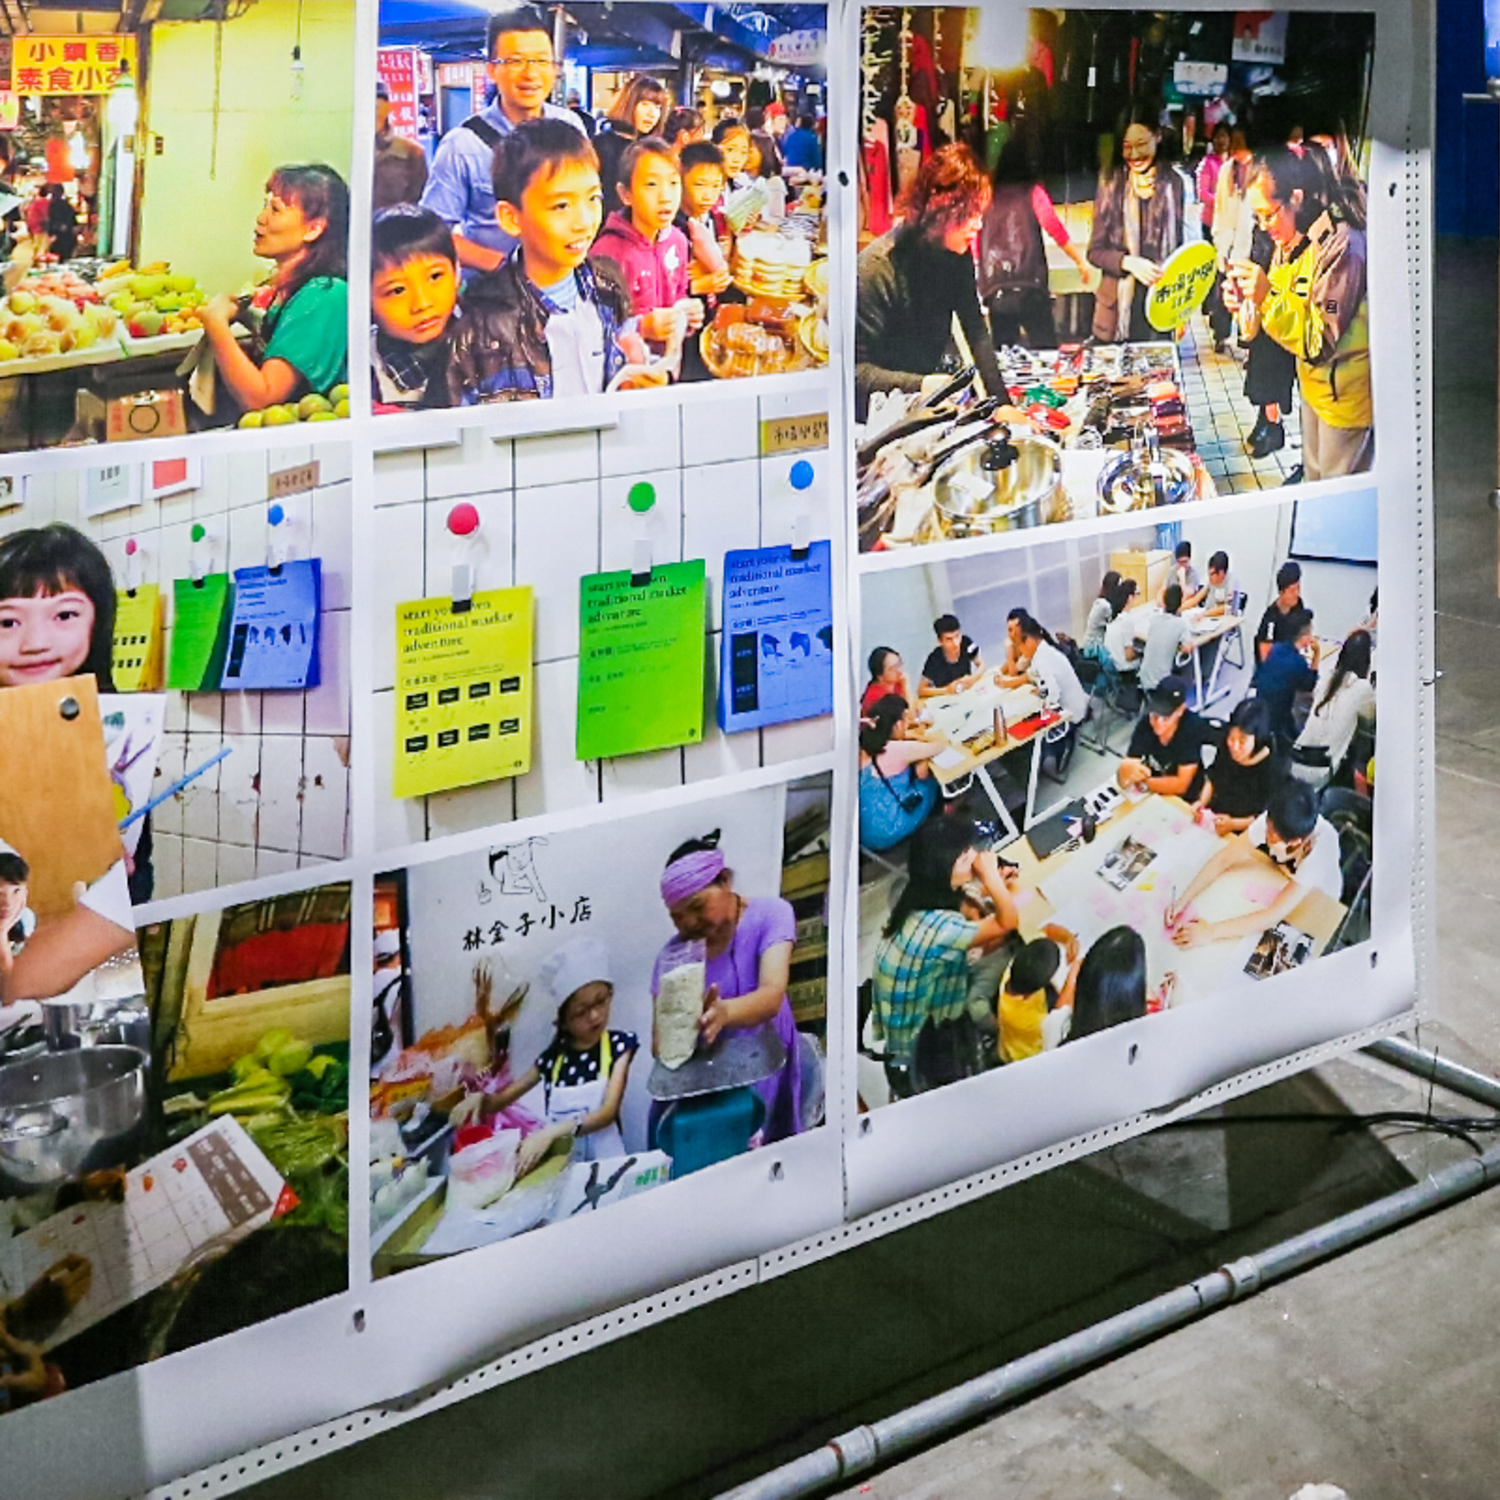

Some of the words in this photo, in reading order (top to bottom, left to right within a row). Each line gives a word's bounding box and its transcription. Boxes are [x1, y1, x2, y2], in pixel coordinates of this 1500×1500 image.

[402, 607, 431, 621] start
[402, 615, 469, 637] traditional
[402, 636, 464, 654] adventure
[462, 895, 593, 953] 林金子小店
